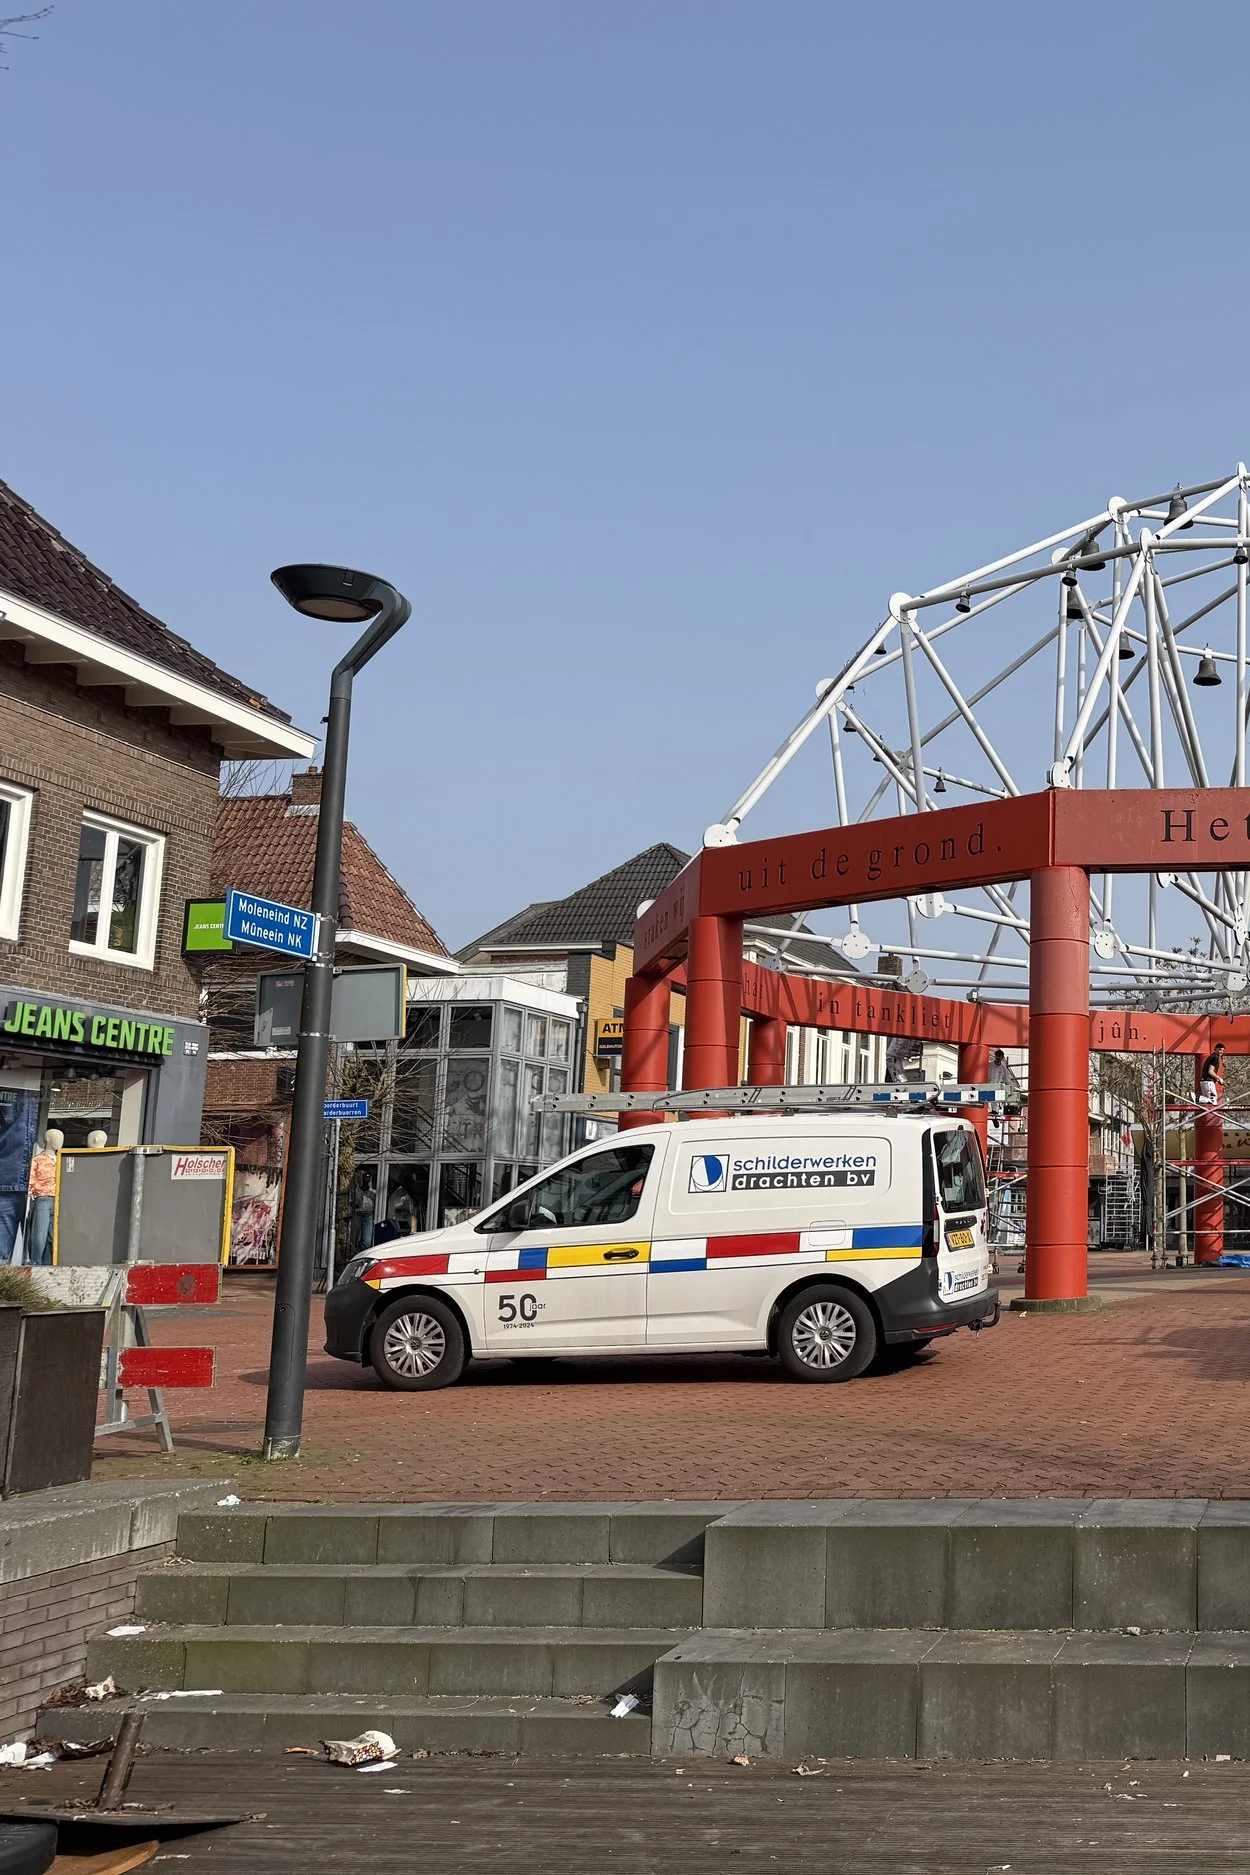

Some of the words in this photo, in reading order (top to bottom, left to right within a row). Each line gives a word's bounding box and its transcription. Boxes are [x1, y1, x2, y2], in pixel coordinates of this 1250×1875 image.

[738, 857, 788, 891] uit
[811, 848, 849, 880] de
[866, 822, 1003, 881] grond.
[238, 898, 290, 925] Moleneind
[293, 915, 308, 930] NZ
[643, 911, 669, 950] staken
[672, 884, 685, 923] wij
[241, 920, 284, 943] Mûneein
[287, 933, 302, 948] NK
[743, 972, 764, 1000] hat
[818, 992, 840, 1014] in
[856, 1000, 951, 1029] tankliet
[4, 1001, 87, 1043] JEANS
[91, 1015, 175, 1056] CENTRE
[174, 1157, 227, 1176] Holscher
[733, 1154, 877, 1172] schilderwerken
[734, 1172, 835, 1189] drachten
[846, 1171, 871, 1185] bv
[498, 1293, 538, 1322] 50
